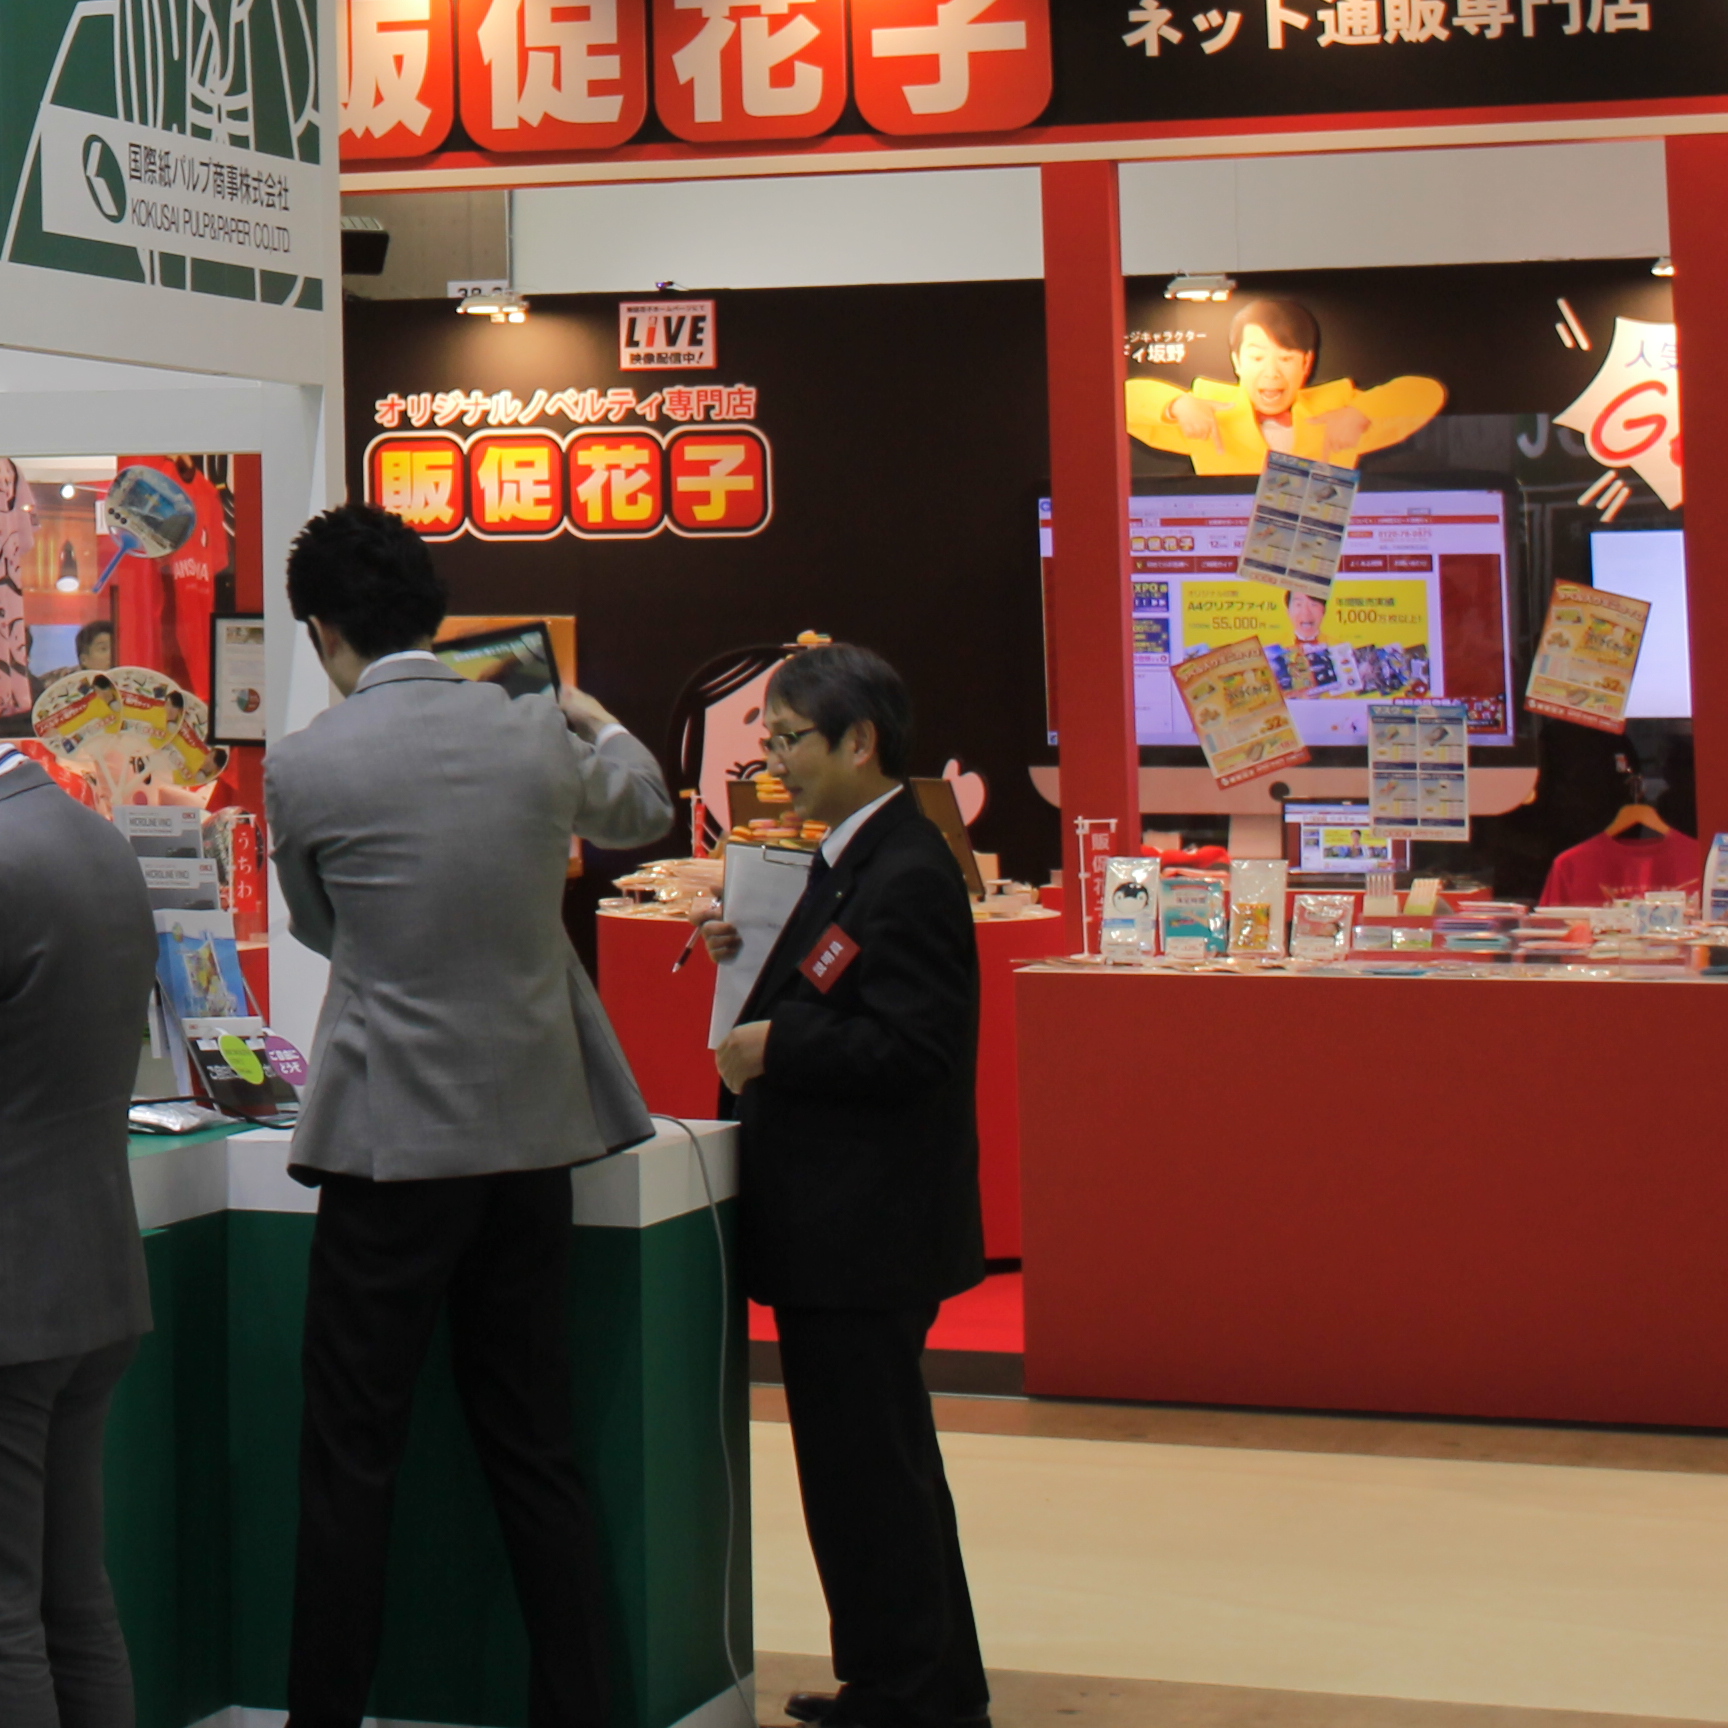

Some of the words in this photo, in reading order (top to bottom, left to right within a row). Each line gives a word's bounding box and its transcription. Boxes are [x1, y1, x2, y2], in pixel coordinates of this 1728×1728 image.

[129, 142, 290, 212] 国際紙パルプ商事株式会社
[131, 198, 180, 235] KOKUSAI
[373, 384, 756, 428] オリジナルノベルティ専門店
[379, 446, 755, 525] 販促花子
[1187, 600, 1278, 614] A4クリアファイル
[237, 831, 253, 899] うちわ
